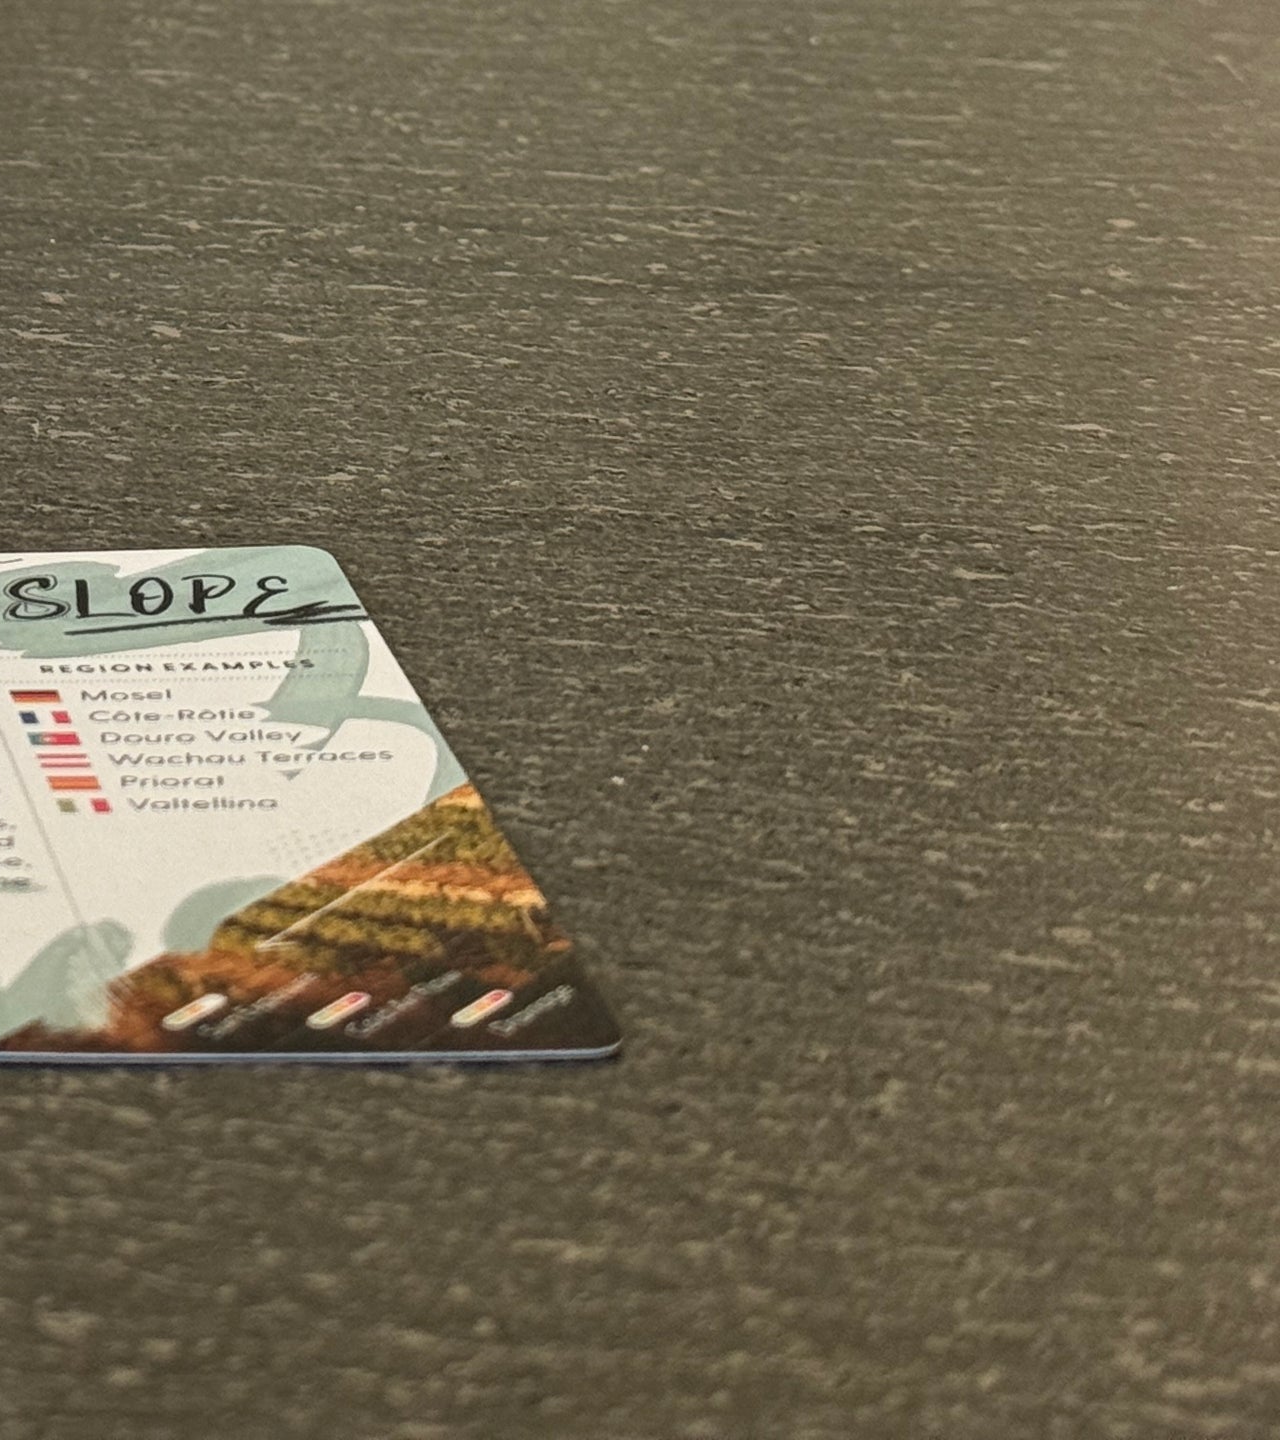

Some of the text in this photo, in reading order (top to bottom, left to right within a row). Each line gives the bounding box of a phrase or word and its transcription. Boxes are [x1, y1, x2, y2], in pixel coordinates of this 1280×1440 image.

[3, 575, 328, 622] SLOPE
[39, 659, 316, 674] REGION EXAMPLES
[81, 689, 171, 702] Mosel
[100, 729, 301, 745] Douro Valley
[108, 749, 394, 766] Wachau Terraces
[120, 775, 224, 788] Priorat
[127, 797, 278, 811] Valtellina
